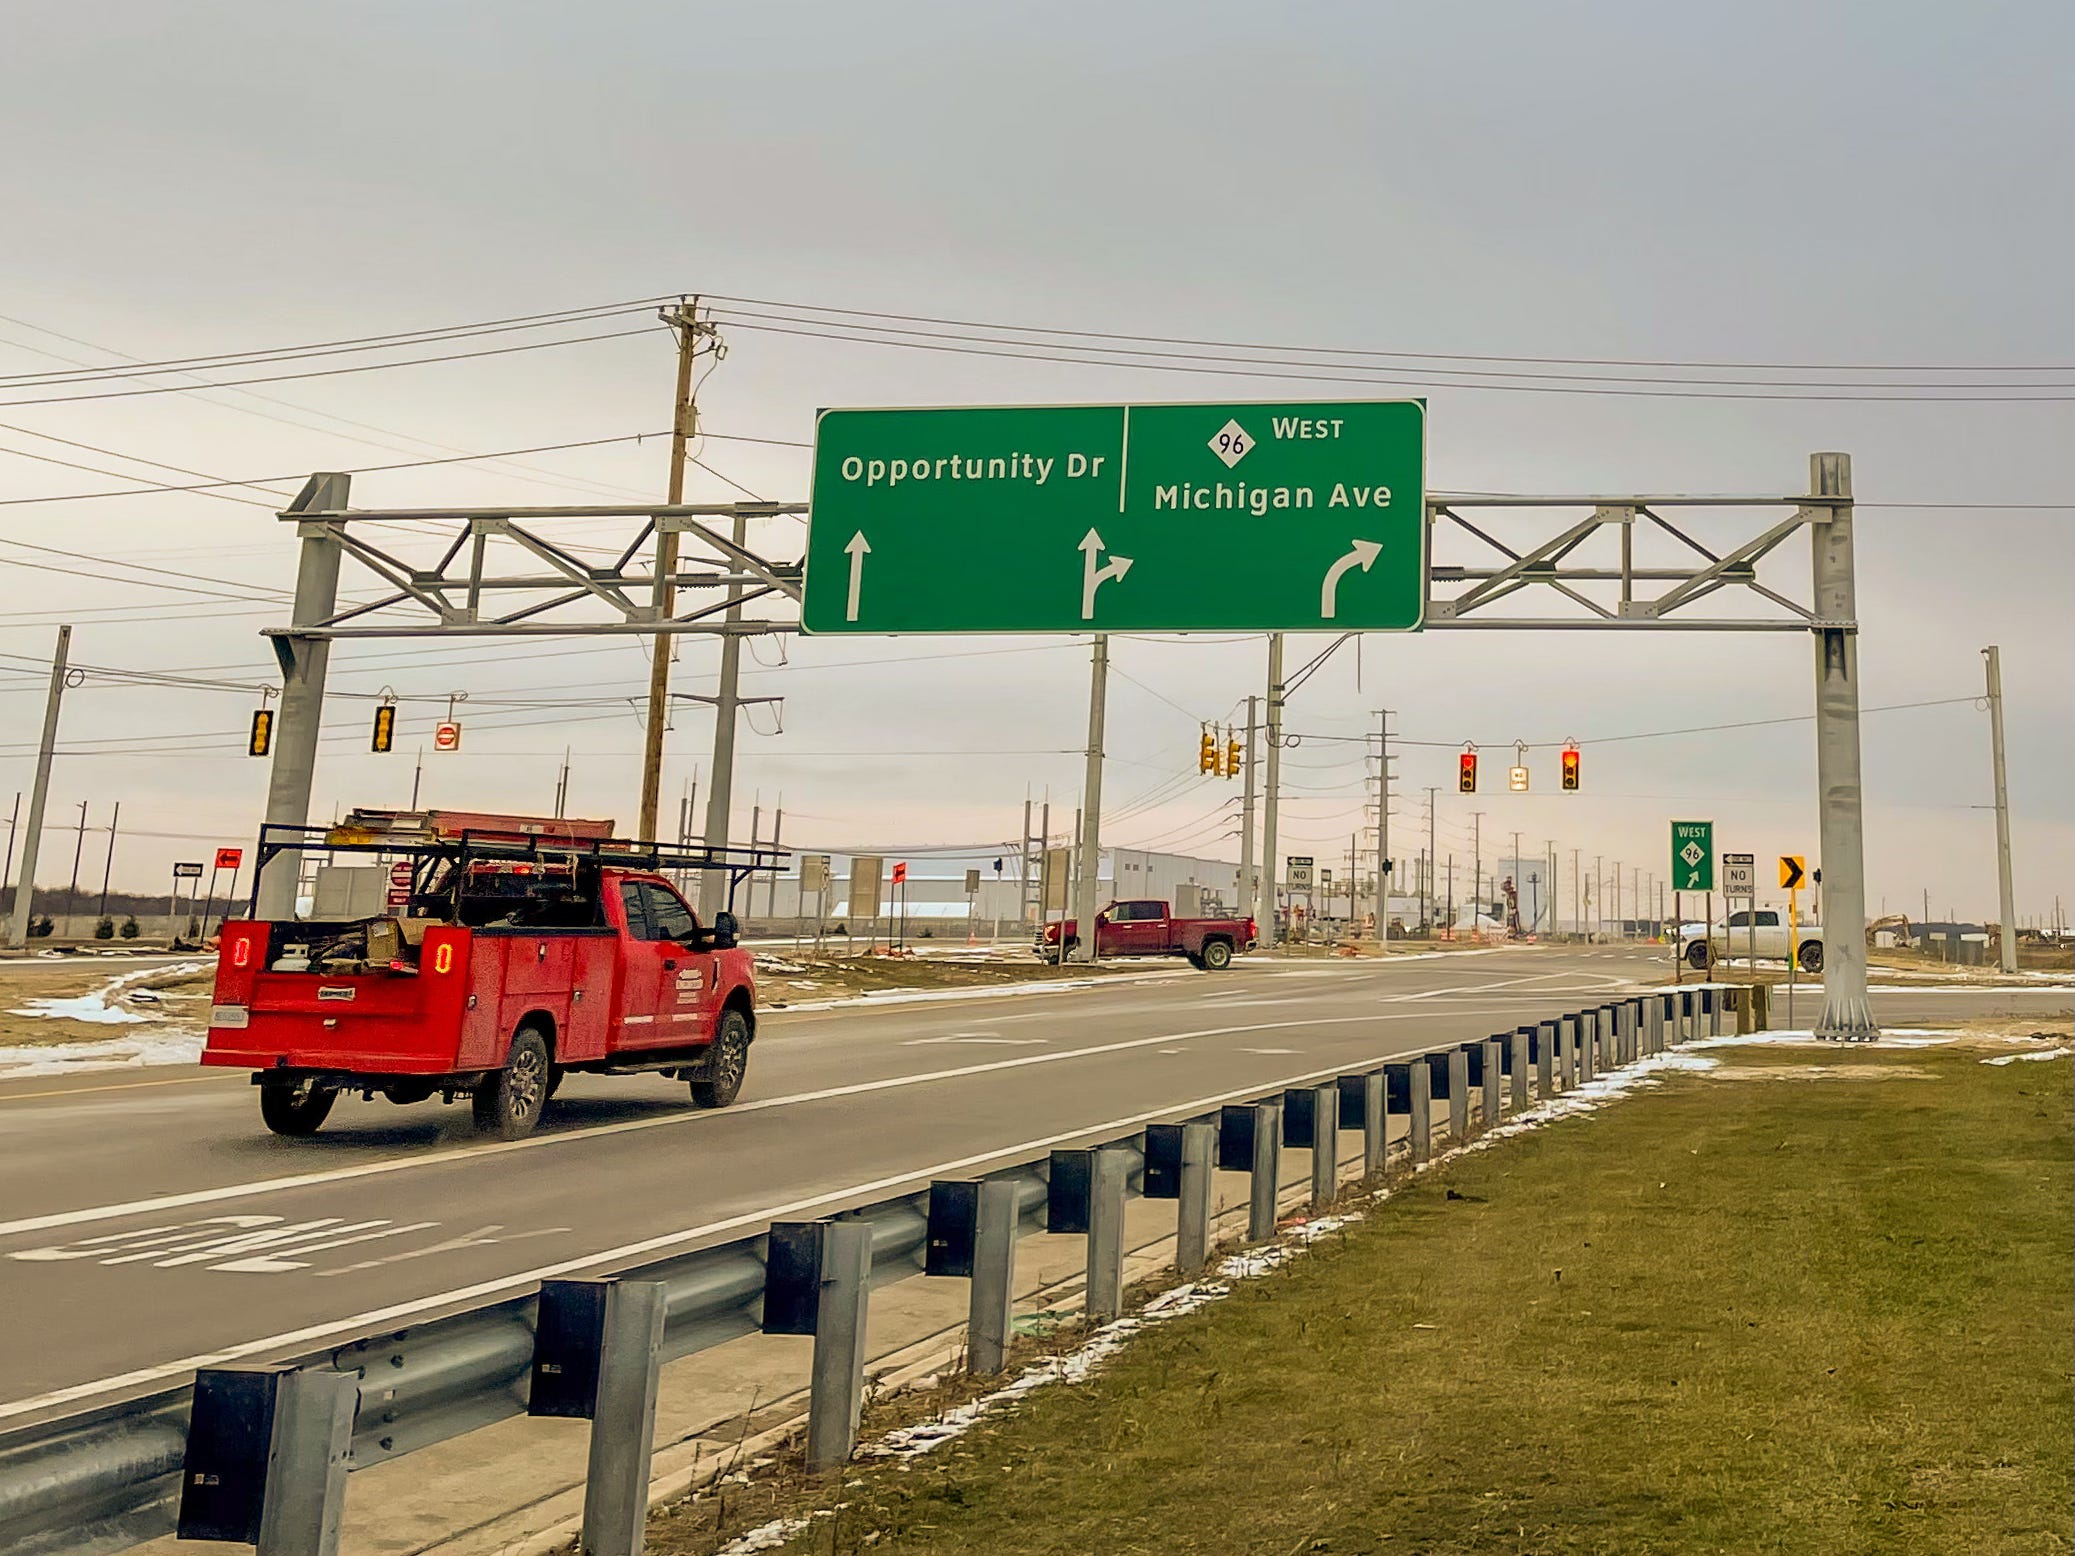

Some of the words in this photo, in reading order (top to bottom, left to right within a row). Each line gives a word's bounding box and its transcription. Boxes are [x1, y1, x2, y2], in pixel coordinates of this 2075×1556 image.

[1218, 433, 1244, 455] 96
[1272, 416, 1344, 440] WEST
[841, 451, 1053, 487] Opportunity
[1067, 453, 1105, 479] Dr
[1154, 483, 1314, 516] Michigan
[1329, 484, 1392, 509] Ave
[1678, 827, 1706, 838] WEST
[1685, 848, 1700, 860] 96
[1293, 870, 1306, 879] NO
[1731, 870, 1746, 880] NO
[1725, 885, 1753, 893] TURNS
[5, 1215, 572, 1276] ONLY
